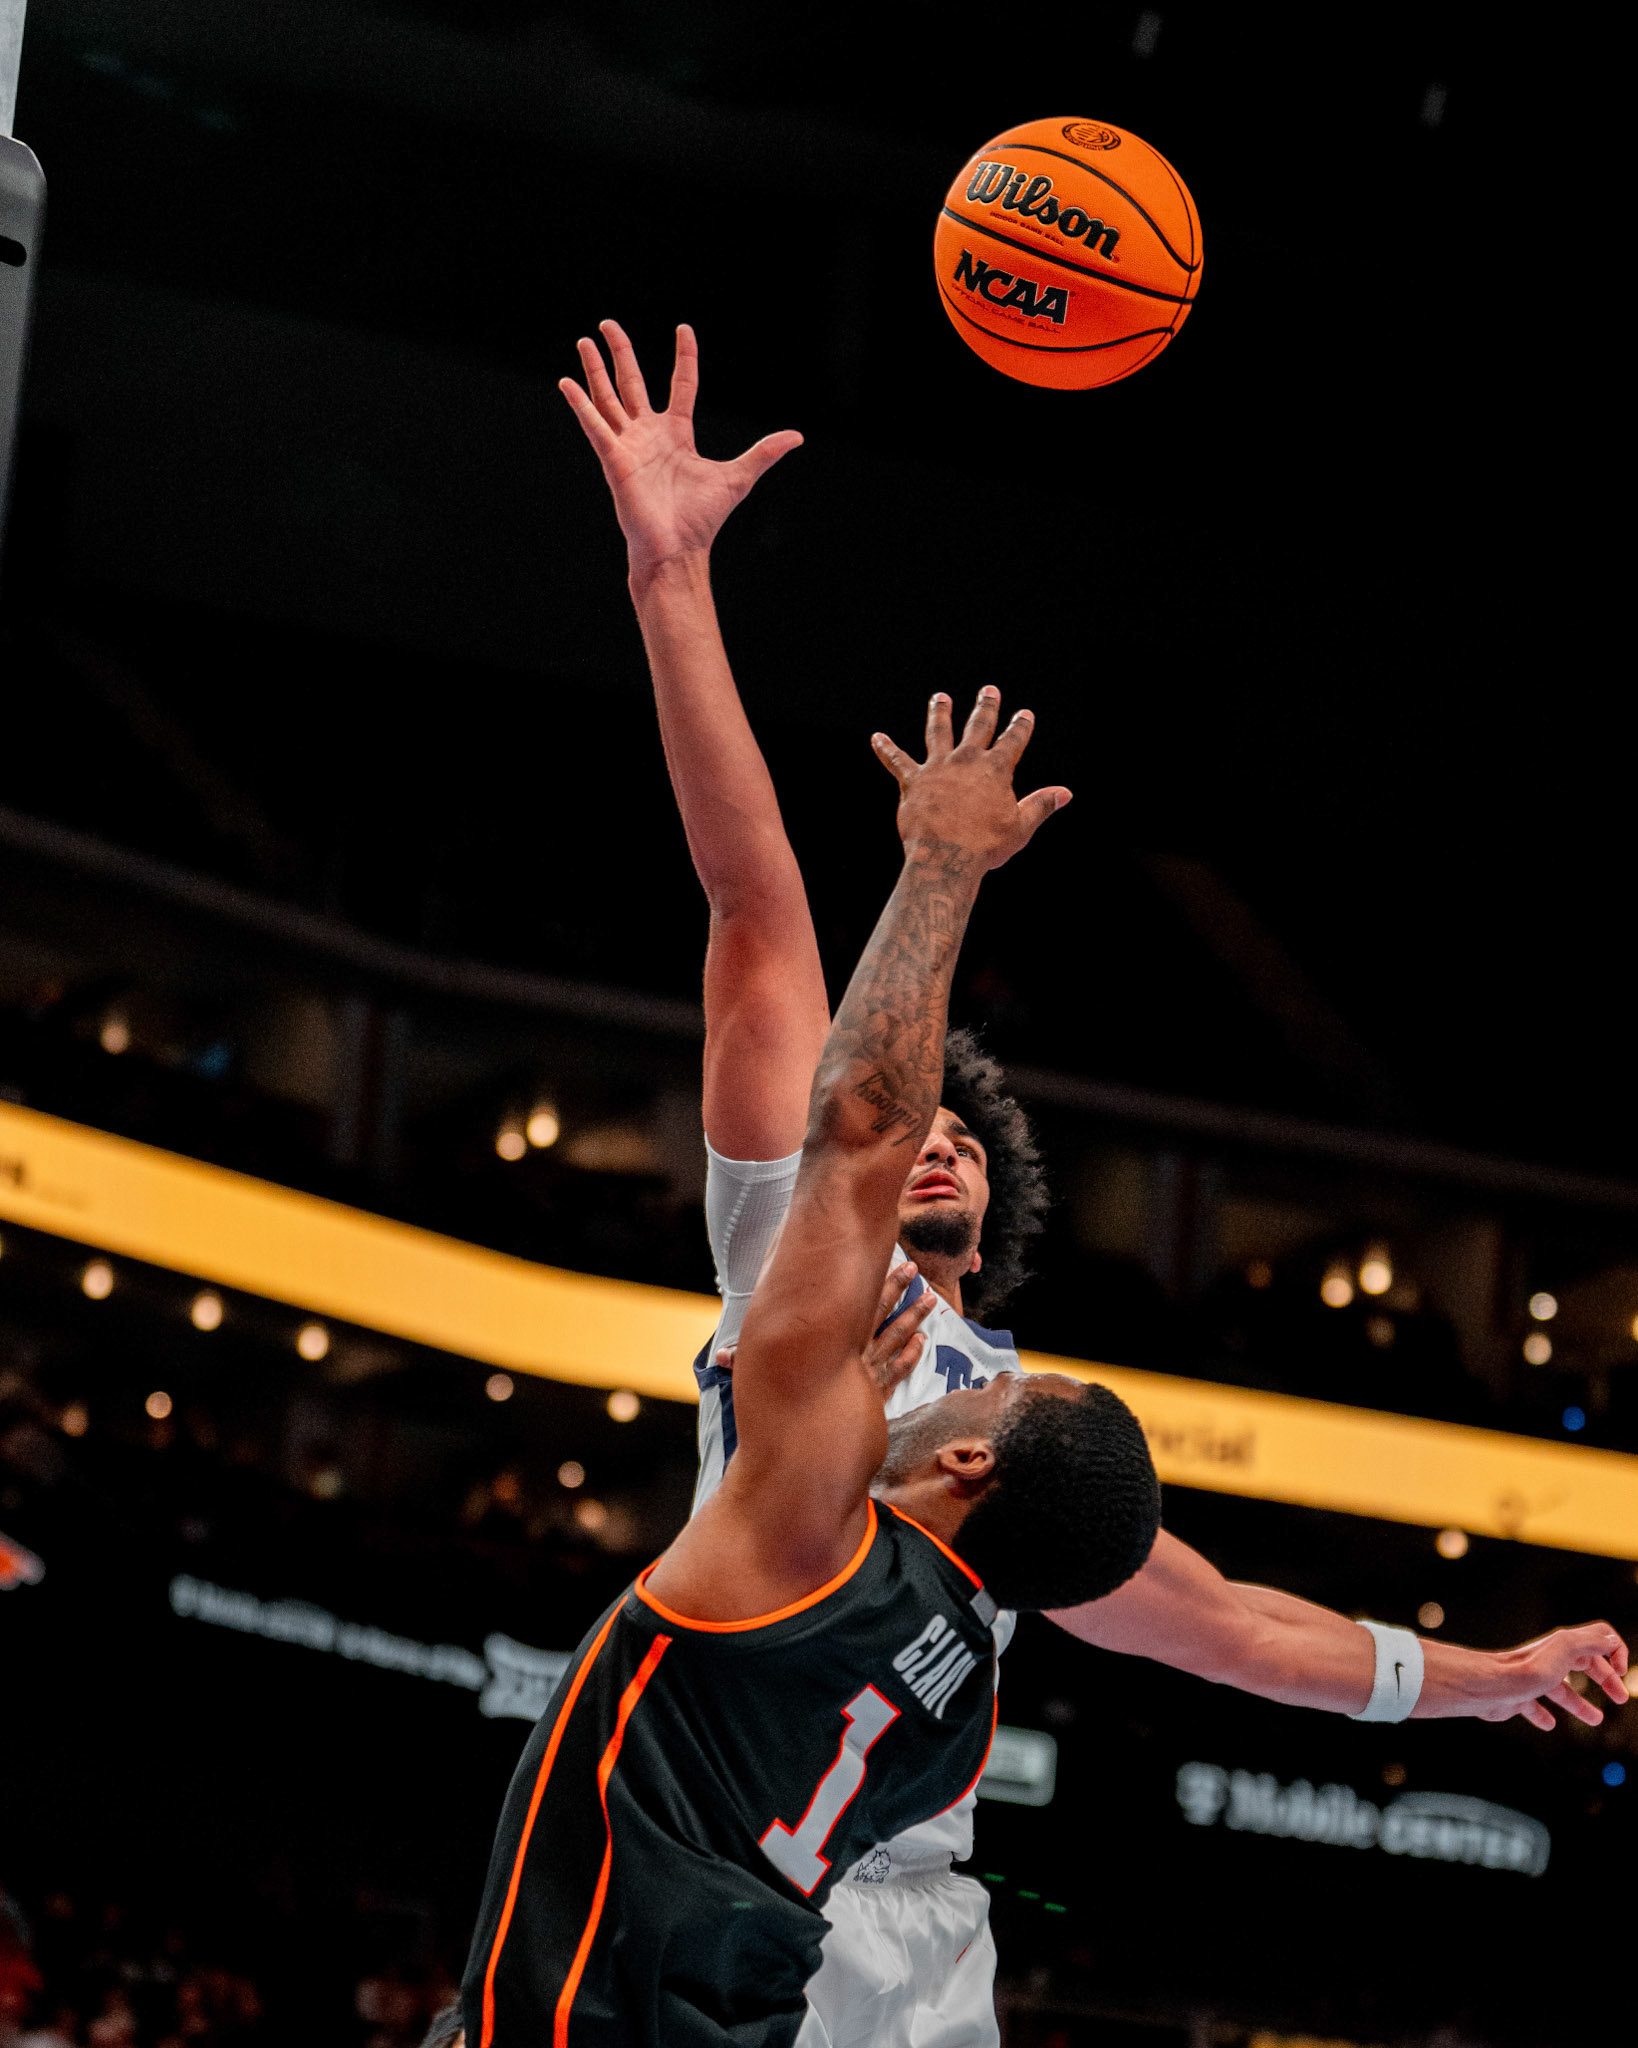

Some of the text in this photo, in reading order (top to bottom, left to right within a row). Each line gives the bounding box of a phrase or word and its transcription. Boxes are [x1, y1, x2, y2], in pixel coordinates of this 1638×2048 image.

[966, 161, 1120, 261] Wilson
[953, 248, 1069, 325] NCAA
[759, 1683, 902, 1897] 1
